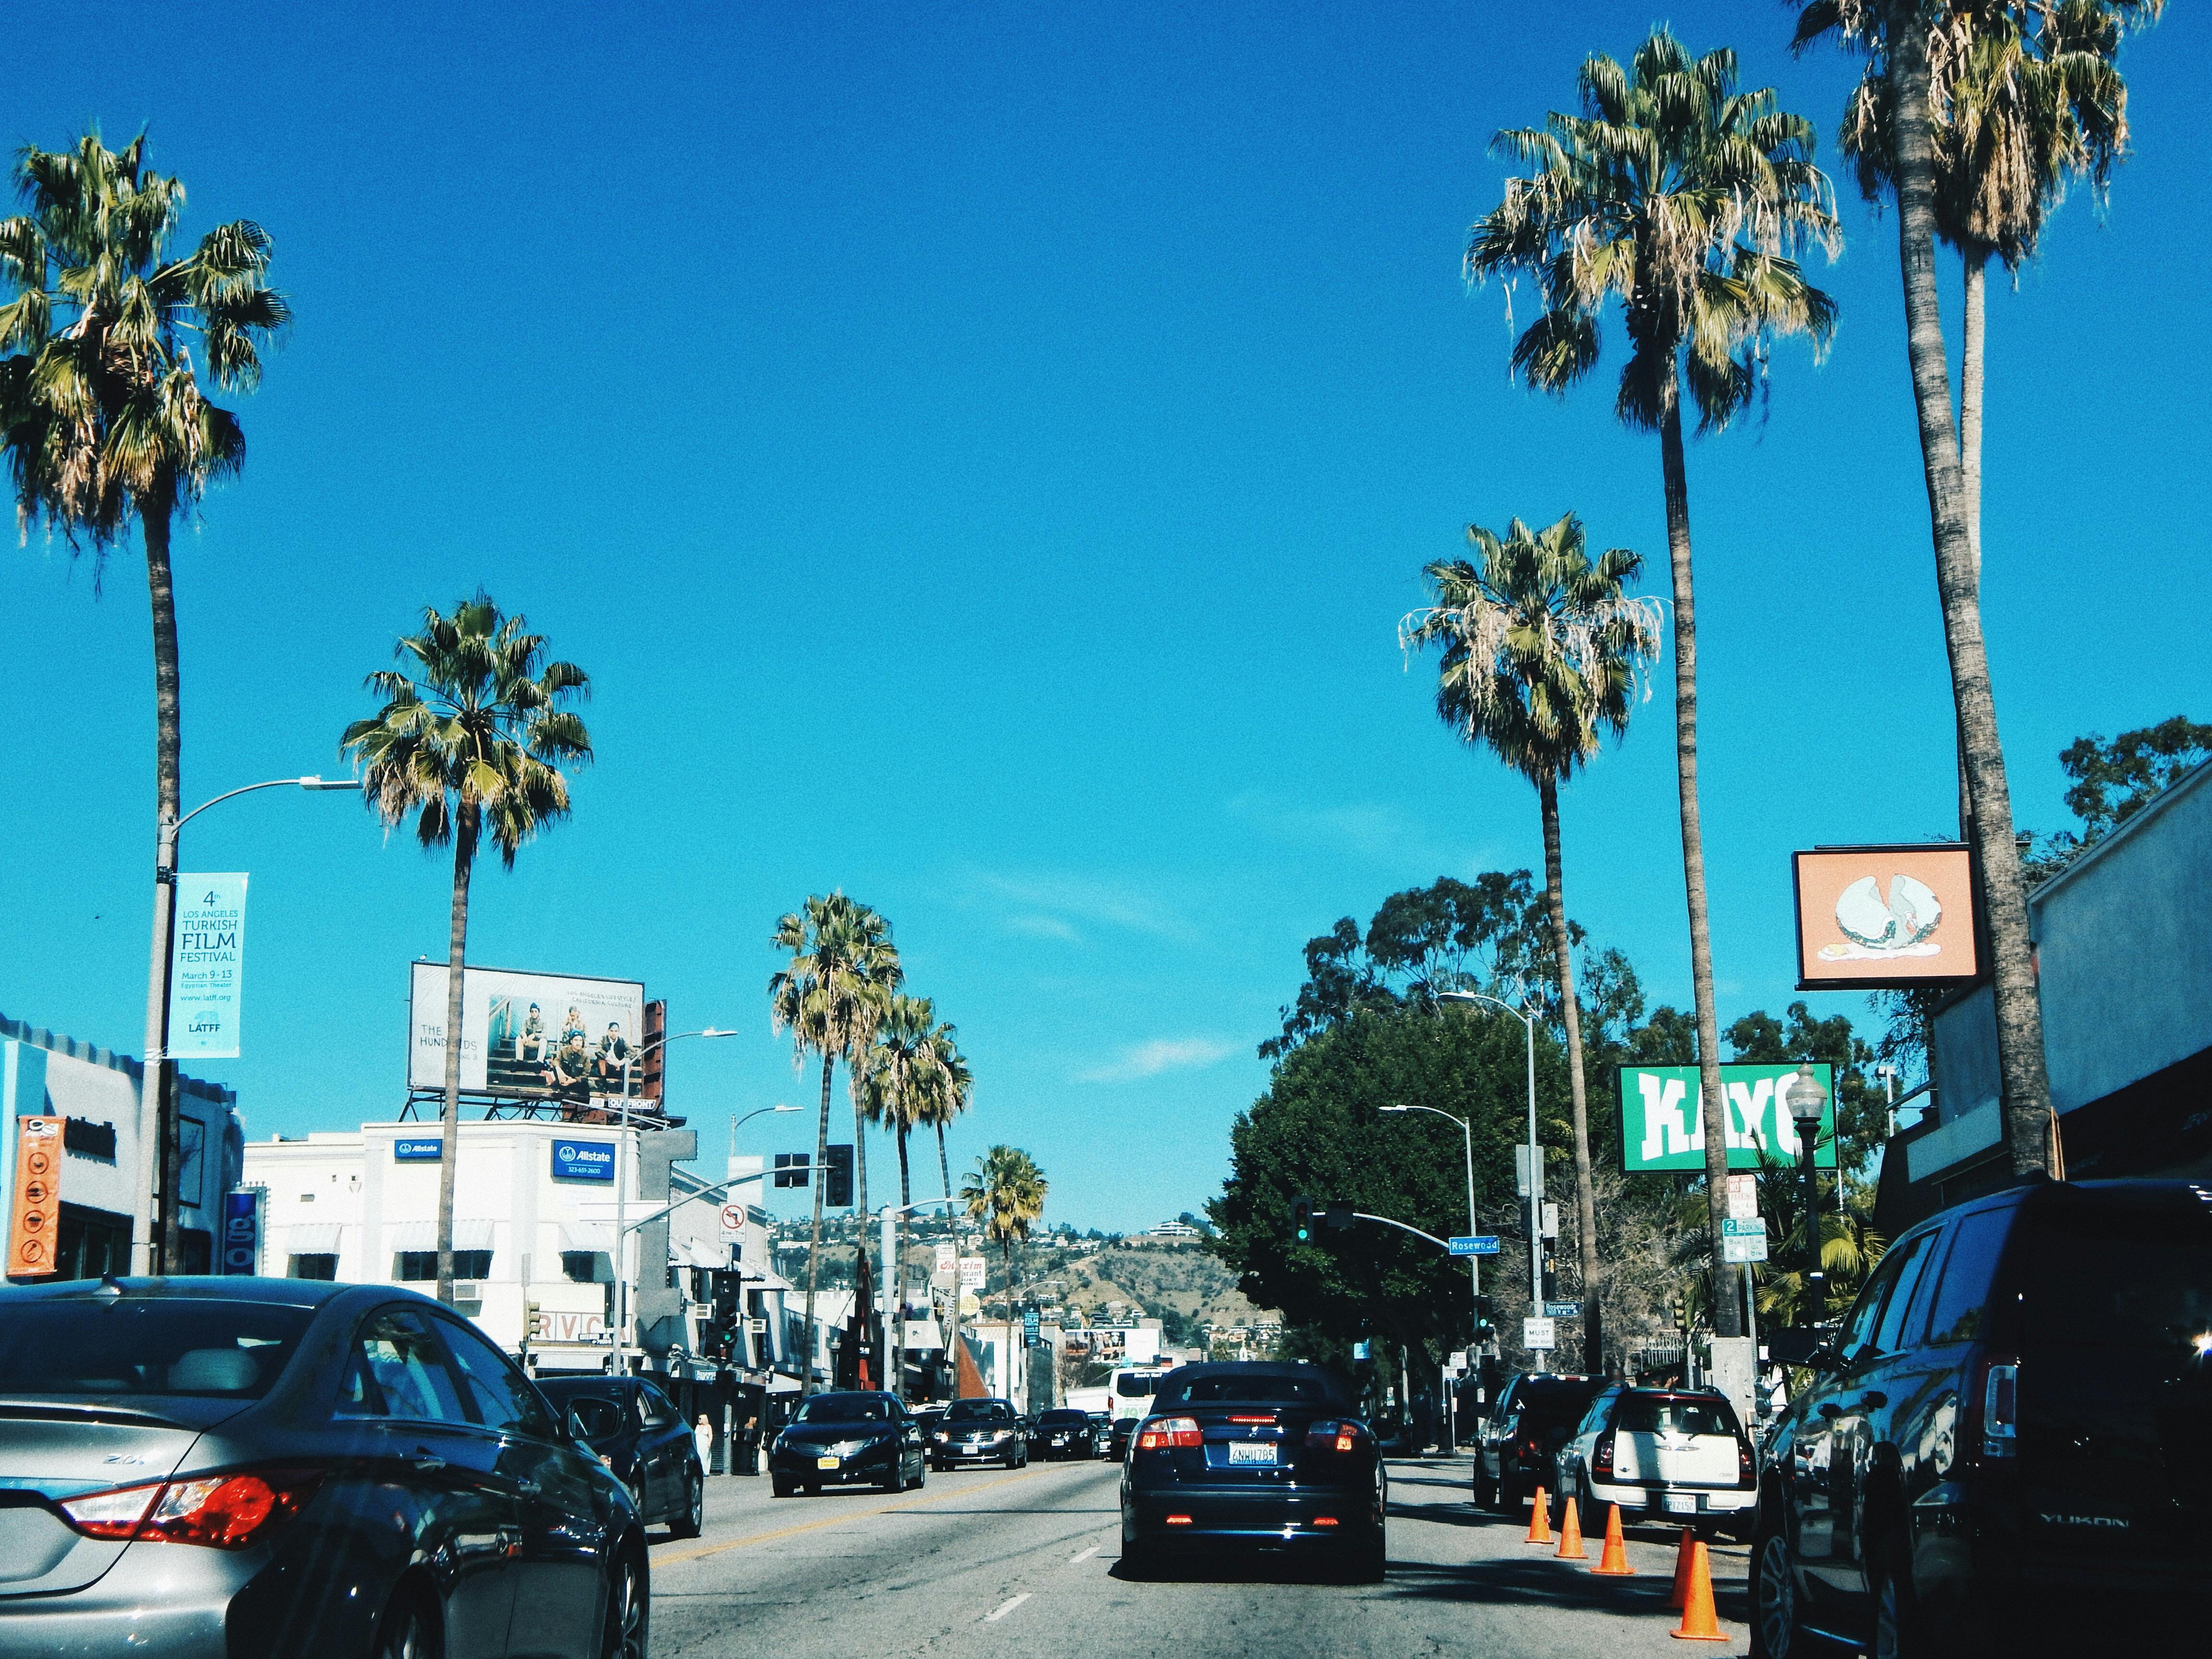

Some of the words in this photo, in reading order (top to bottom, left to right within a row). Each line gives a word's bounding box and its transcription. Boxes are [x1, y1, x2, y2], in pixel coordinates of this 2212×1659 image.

[203, 891, 221, 907] 4th
[183, 920, 237, 931] TURKISH
[182, 932, 236, 950] FILM
[180, 951, 236, 962] FESTIVAL
[189, 1024, 220, 1032] LATFF
[421, 1024, 442, 1035] THE
[421, 1036, 477, 1051] HUNDDS
[610, 1099, 654, 1108] OUFRONT
[577, 1150, 611, 1162] Allstate
[1730, 1182, 1739, 1191] NO
[1727, 1221, 1734, 1231] 2
[1738, 1224, 1763, 1232] PARKING
[1452, 1241, 1497, 1250] Rosewood
[940, 1261, 982, 1270] Mxim
[2041, 1513, 2129, 1527] YUKON
